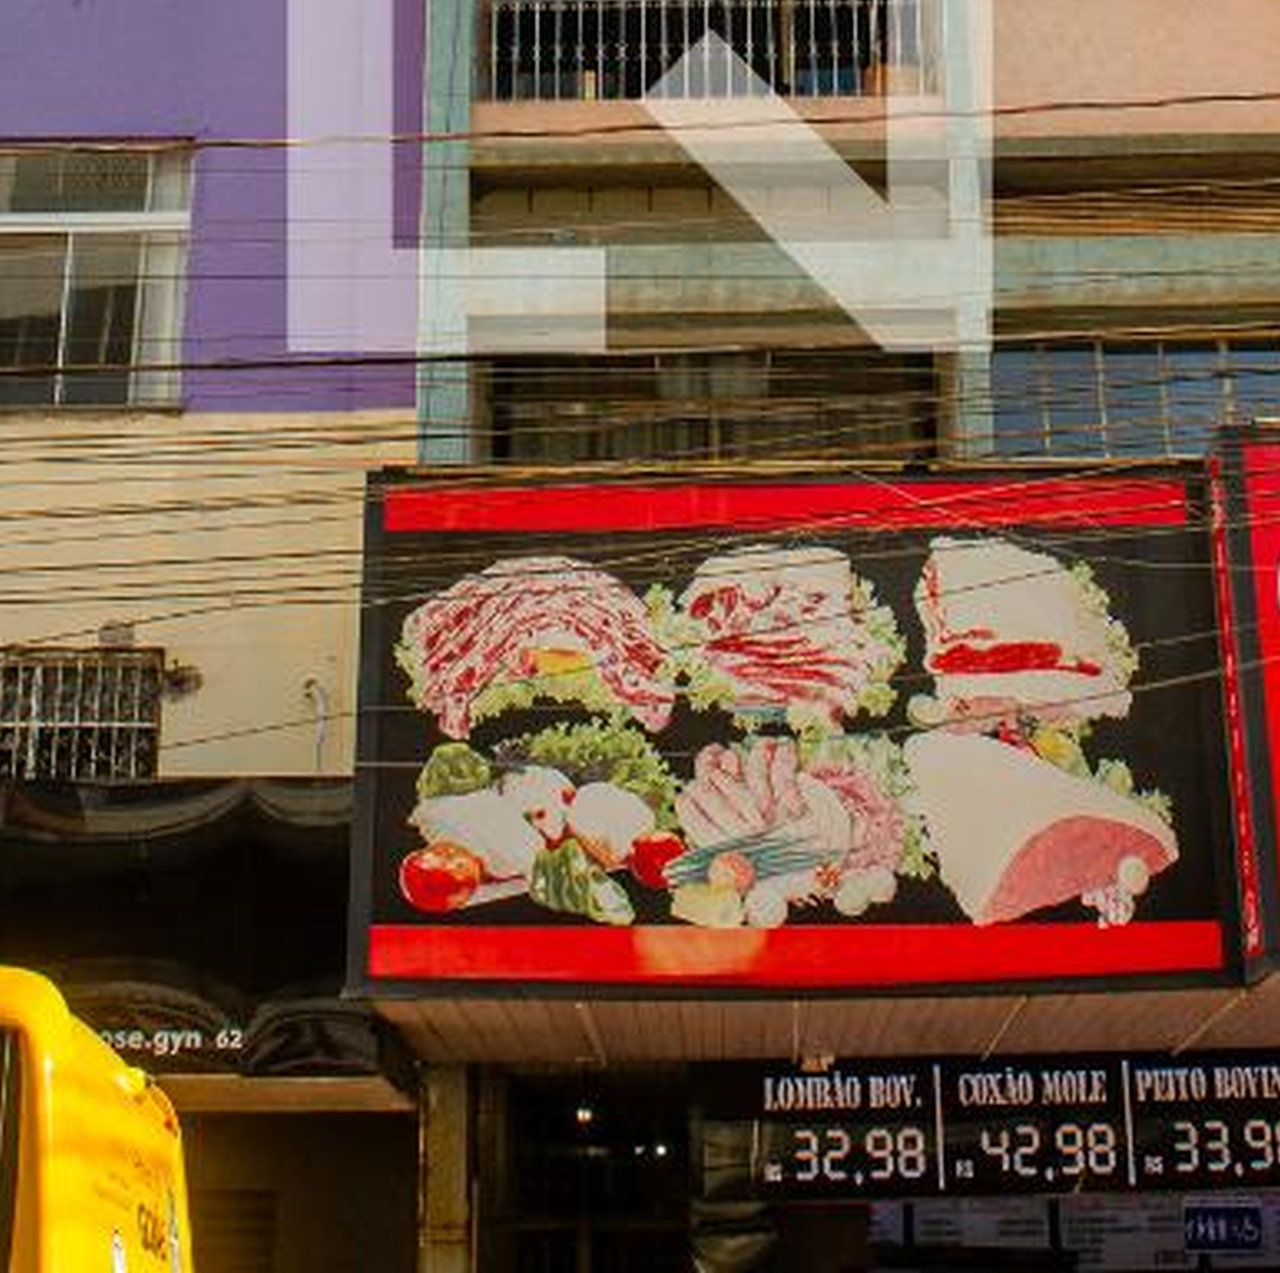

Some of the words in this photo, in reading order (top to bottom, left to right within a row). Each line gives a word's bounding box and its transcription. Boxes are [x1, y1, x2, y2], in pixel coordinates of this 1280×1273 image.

[100, 1029, 202, 1056] ose.gyn
[1042, 1070, 1108, 1105] MOLE
[1134, 1066, 1208, 1102] PEITO
[794, 1127, 926, 1187] 32,98
[980, 1122, 1117, 1182] 42,98
